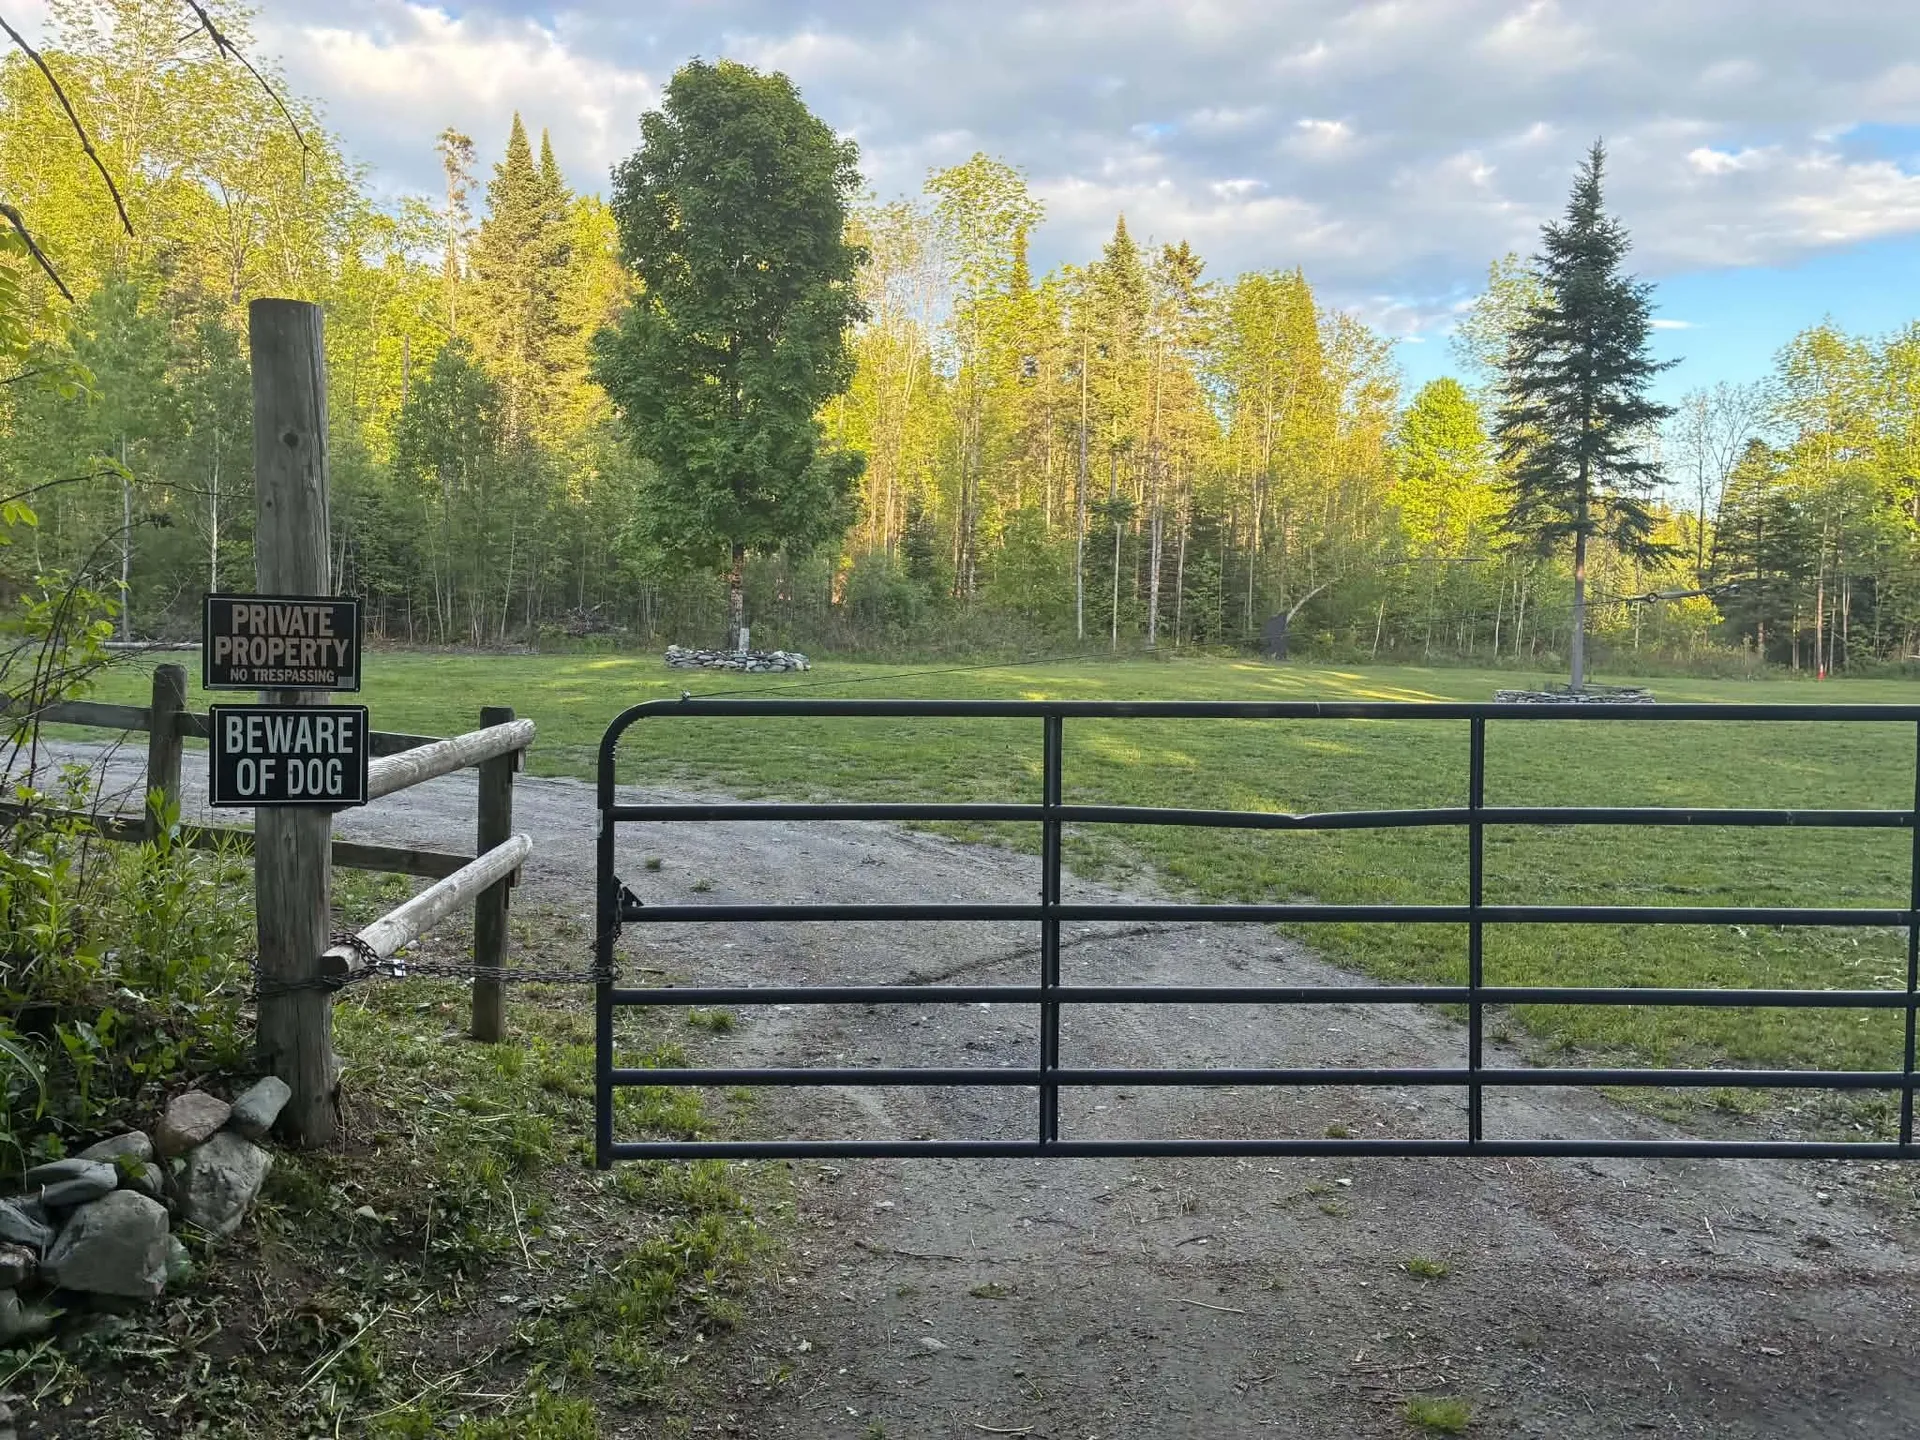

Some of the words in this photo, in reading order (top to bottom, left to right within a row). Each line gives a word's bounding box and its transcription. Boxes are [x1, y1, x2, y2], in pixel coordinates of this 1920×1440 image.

[231, 604, 334, 636] PRIVATE
[215, 636, 349, 667] PROPERTY
[230, 668, 248, 682] NO
[252, 668, 335, 683] TRESPASSING
[225, 715, 354, 754] BEWARE
[236, 758, 276, 796] OF
[287, 758, 343, 796] DOG
